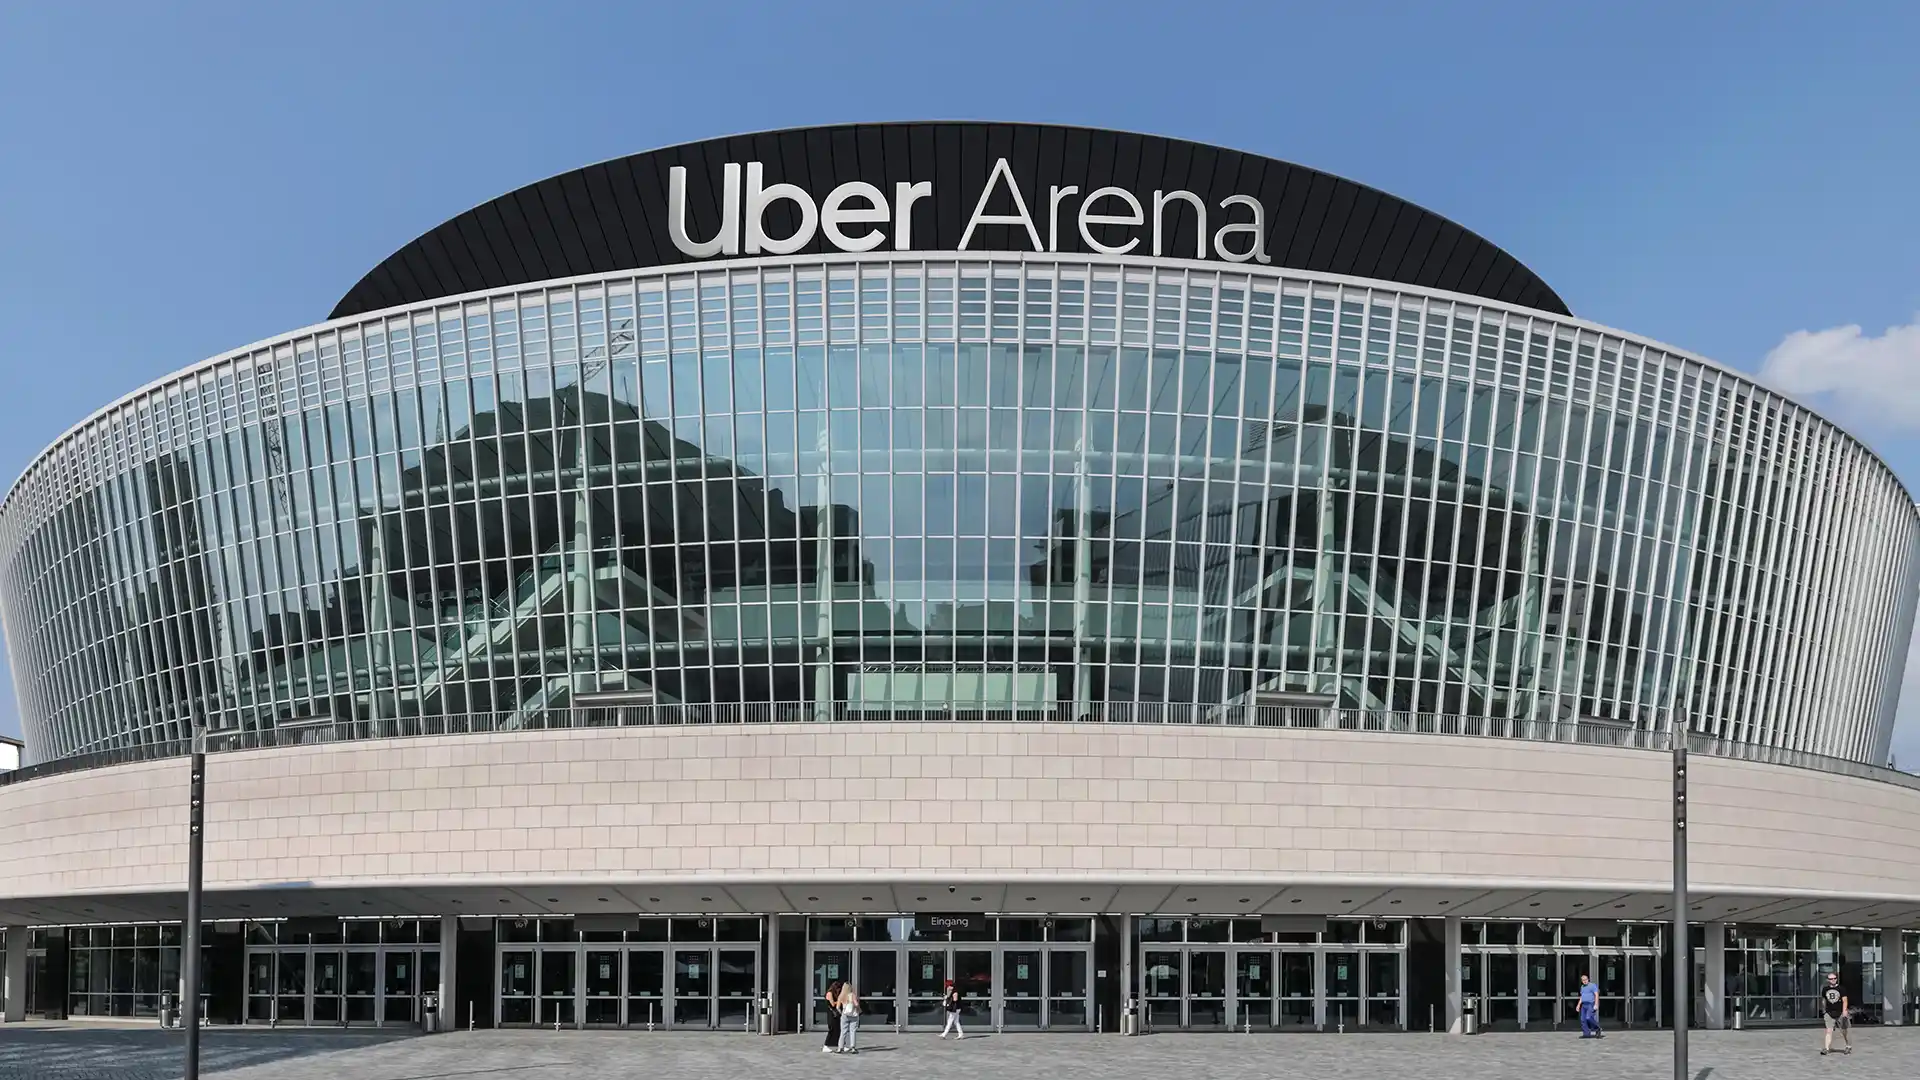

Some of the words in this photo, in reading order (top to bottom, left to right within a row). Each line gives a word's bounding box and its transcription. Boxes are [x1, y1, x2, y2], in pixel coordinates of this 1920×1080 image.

[668, 161, 932, 258] Uber
[957, 157, 1271, 265] Arena
[931, 917, 969, 927] Eingang
